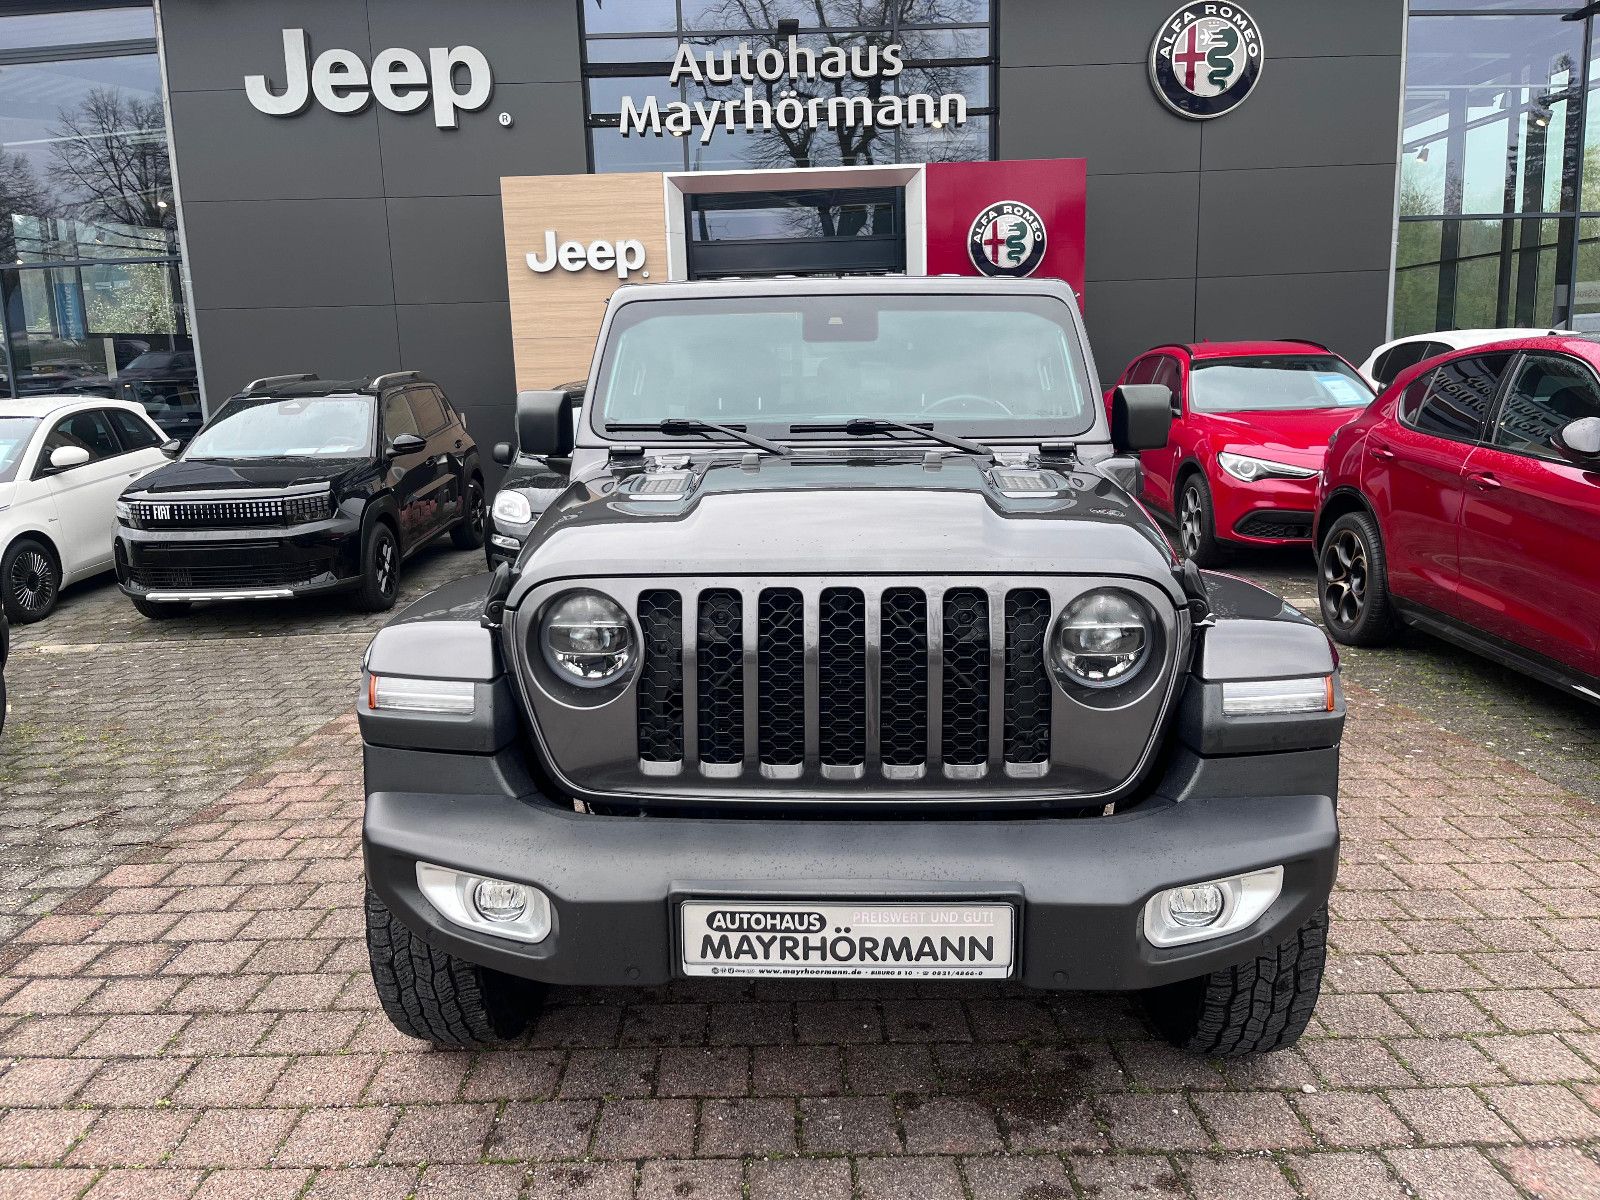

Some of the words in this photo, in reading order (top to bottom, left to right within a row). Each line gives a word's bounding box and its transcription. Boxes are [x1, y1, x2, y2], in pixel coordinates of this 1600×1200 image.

[1160, 11, 1196, 59] ALFA
[1205, 4, 1258, 57] ROMEO
[669, 34, 904, 83] Autohaus
[244, 28, 492, 128] Jeep
[619, 88, 967, 143] Mayrhörmann
[973, 210, 998, 243] ALFA
[1003, 205, 1043, 241] ROMEO
[525, 228, 646, 279] Jeep
[152, 505, 171, 520] FIAT
[712, 912, 821, 931] AUTOHAUS
[853, 911, 926, 923] PREISWERT
[931, 911, 958, 923] UND
[963, 911, 994, 923] GUT!
[700, 926, 994, 962] MAYRHÖRMANN
[758, 967, 862, 976] www.mayrhoermann.de
